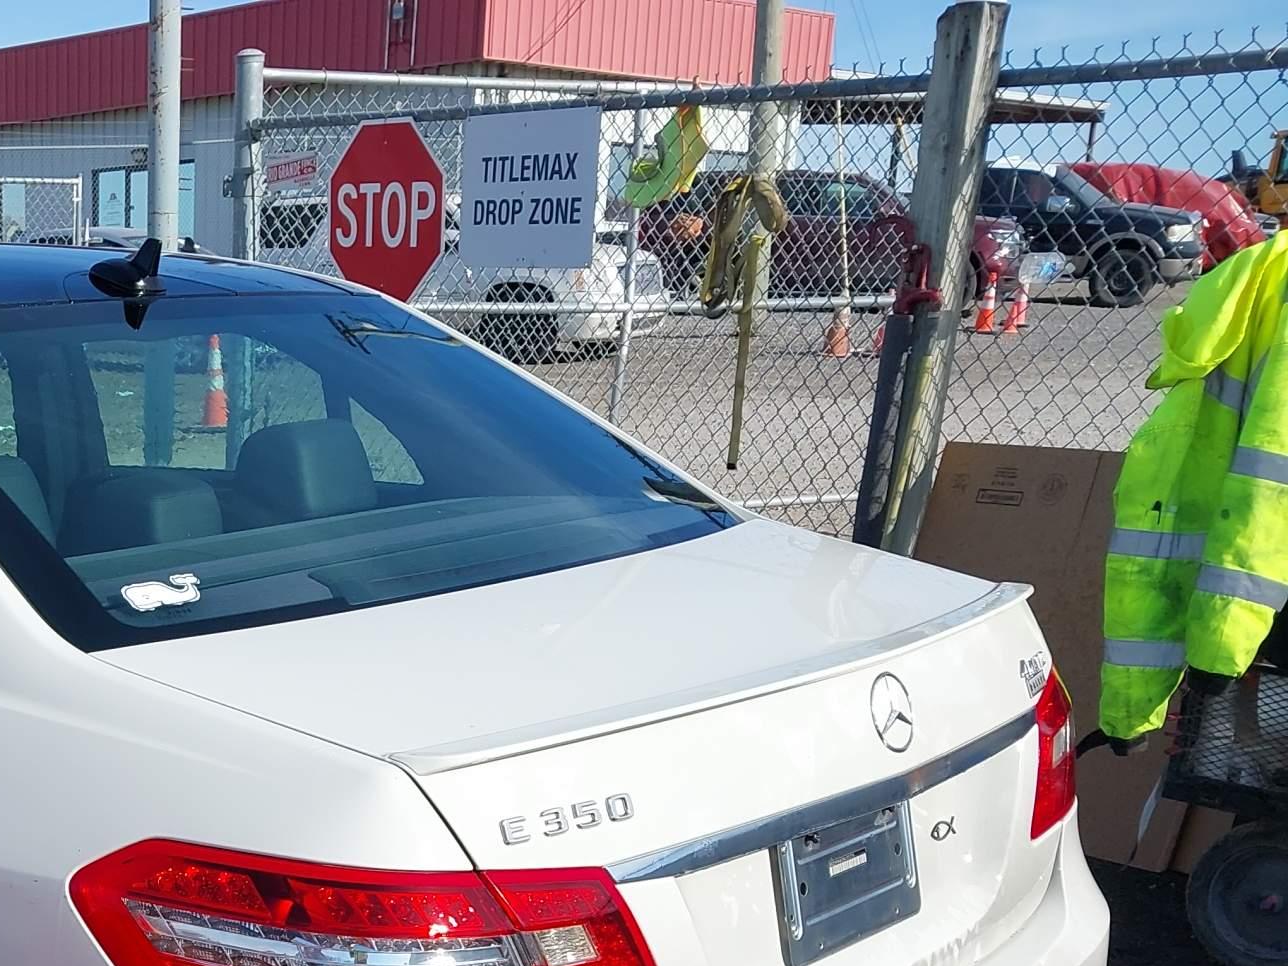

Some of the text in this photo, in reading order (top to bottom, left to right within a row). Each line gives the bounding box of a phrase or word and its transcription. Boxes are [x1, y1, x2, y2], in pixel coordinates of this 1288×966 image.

[481, 152, 579, 184] TITLEMAX
[335, 181, 437, 249] STOP
[473, 196, 582, 226] DROP ZONE
[499, 793, 634, 845] E 350
